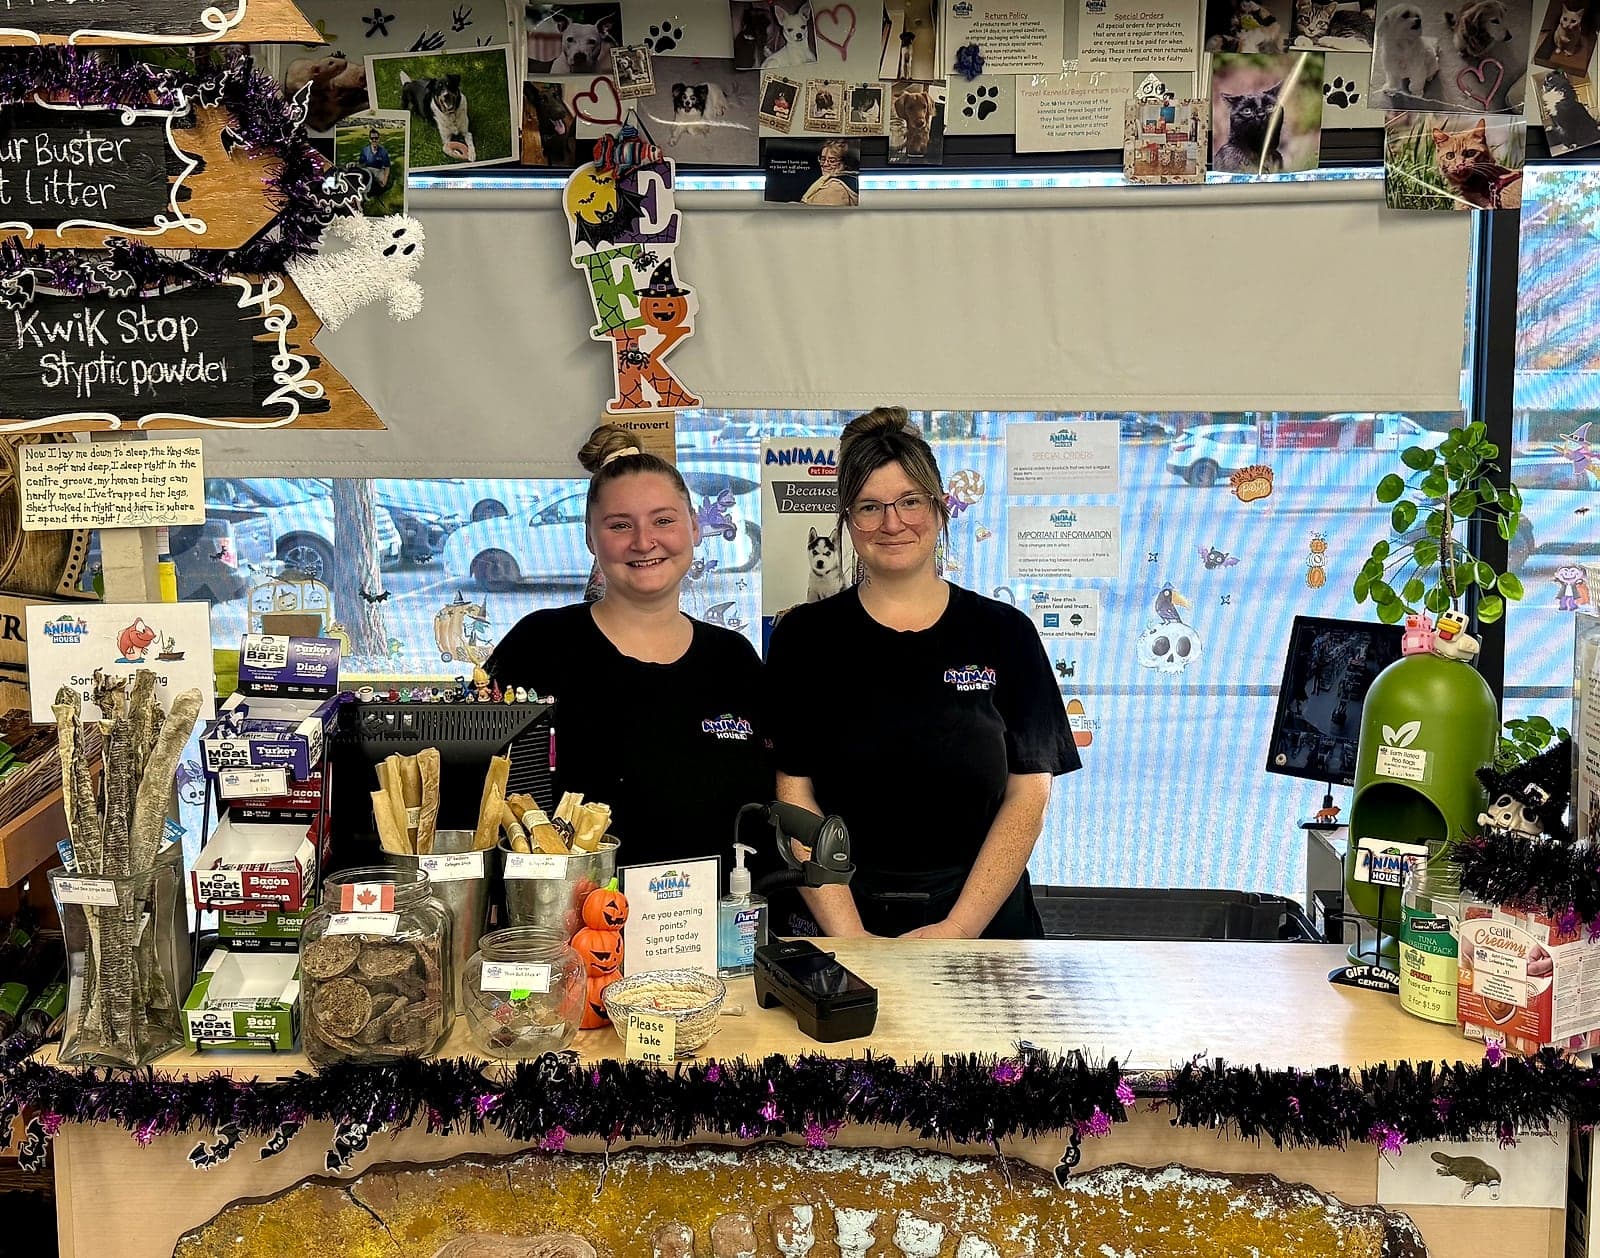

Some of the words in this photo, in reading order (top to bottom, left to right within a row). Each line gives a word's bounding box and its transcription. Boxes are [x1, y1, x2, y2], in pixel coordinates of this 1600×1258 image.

[35, 130, 131, 166] Buster
[25, 169, 116, 209] Litter
[116, 309, 199, 353] Stop
[765, 447, 836, 465] ANIMAL
[786, 483, 839, 496] Because
[781, 499, 836, 511] Deserves
[1018, 531, 1058, 539] IMPORTANT
[1060, 531, 1112, 539] INFORMATION
[0, 613, 26, 642] R
[43, 623, 89, 635] ANIMAL
[52, 635, 80, 643] HOUSE
[247, 643, 285, 652] Meat
[294, 644, 333, 655] Turkey
[246, 651, 284, 661] Bars
[296, 663, 327, 671] Dinde
[70, 675, 94, 685] Sorr
[943, 669, 997, 685] ANIMAL
[956, 682, 990, 691] HOUSE
[702, 719, 753, 734] ANIMAL
[716, 731, 748, 740] HOUSE
[208, 750, 248, 758] Meat
[256, 746, 297, 757] Turkey
[1403, 751, 1420, 759] Rated
[200, 882, 240, 890] Meat
[250, 877, 289, 885] Bacon
[648, 877, 691, 893] ANIMAL
[200, 889, 240, 898] Bars
[656, 890, 683, 900] HOUSE
[642, 913, 656, 921] Are
[657, 911, 672, 922] you
[673, 907, 703, 917] earning
[659, 920, 687, 932] points?
[646, 936, 663, 945] Sign
[665, 936, 675, 944] up
[676, 931, 699, 942] today
[1419, 936, 1438, 945] TUNA
[1475, 929, 1526, 958] Creamy
[655, 947, 674, 956] start
[675, 943, 701, 954] Saving
[1345, 965, 1370, 979] GIFT
[1459, 969, 1471, 980] 72
[1358, 978, 1389, 989] CENTER
[247, 1018, 276, 1026] Beef
[630, 1018, 664, 1033] Please
[191, 1029, 232, 1037] Bars
[637, 1033, 661, 1046] take
[642, 1052, 661, 1061] one
